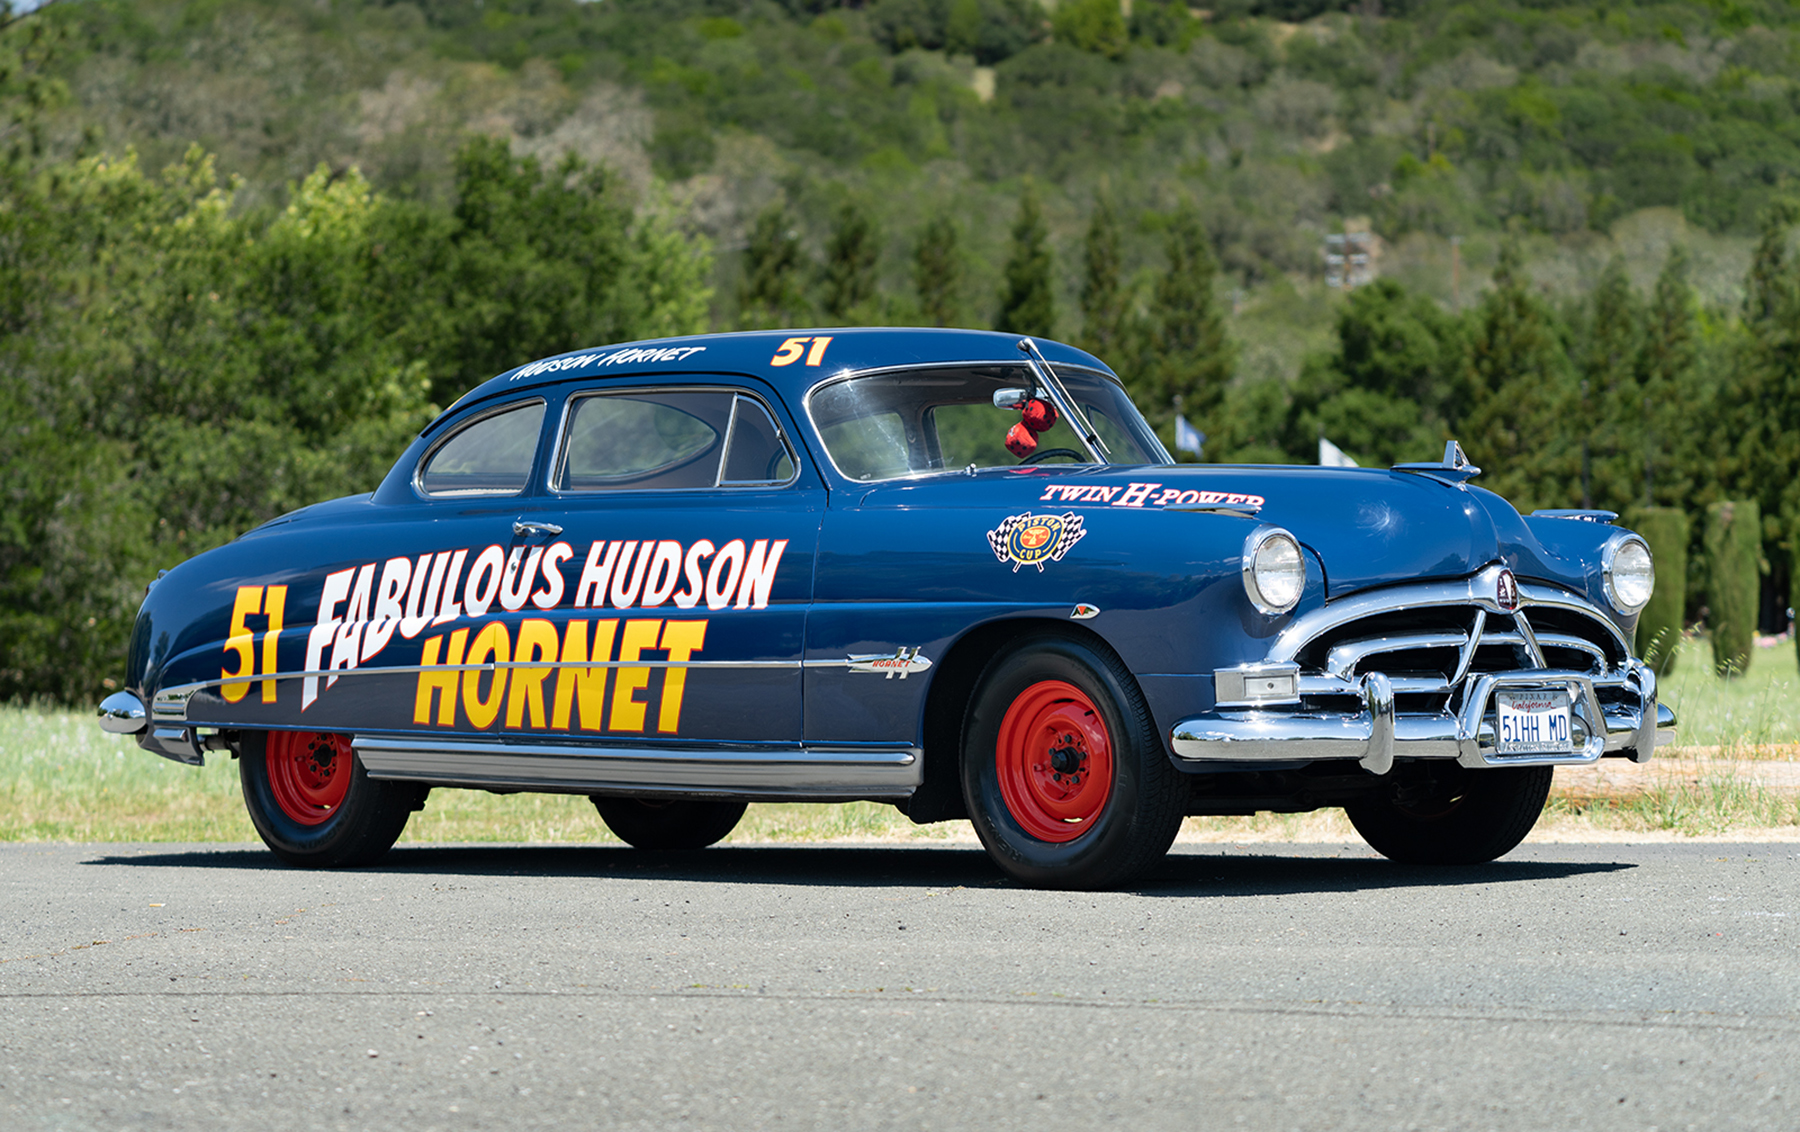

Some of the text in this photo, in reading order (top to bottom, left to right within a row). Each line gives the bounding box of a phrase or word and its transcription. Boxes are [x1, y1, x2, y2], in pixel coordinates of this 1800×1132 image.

[510, 347, 707, 382] HUDSON HORNET
[770, 336, 834, 367] 51
[1040, 484, 1123, 503] TWIN
[1017, 517, 1061, 532] PISTON
[1020, 549, 1042, 560] CUP
[301, 538, 789, 713] FABULOUS HUDSON
[220, 584, 288, 704] 51
[413, 618, 709, 734] HORNET
[872, 660, 911, 668] HORNET
[1511, 700, 1557, 713] California
[1502, 714, 1568, 742] 51HH MD
